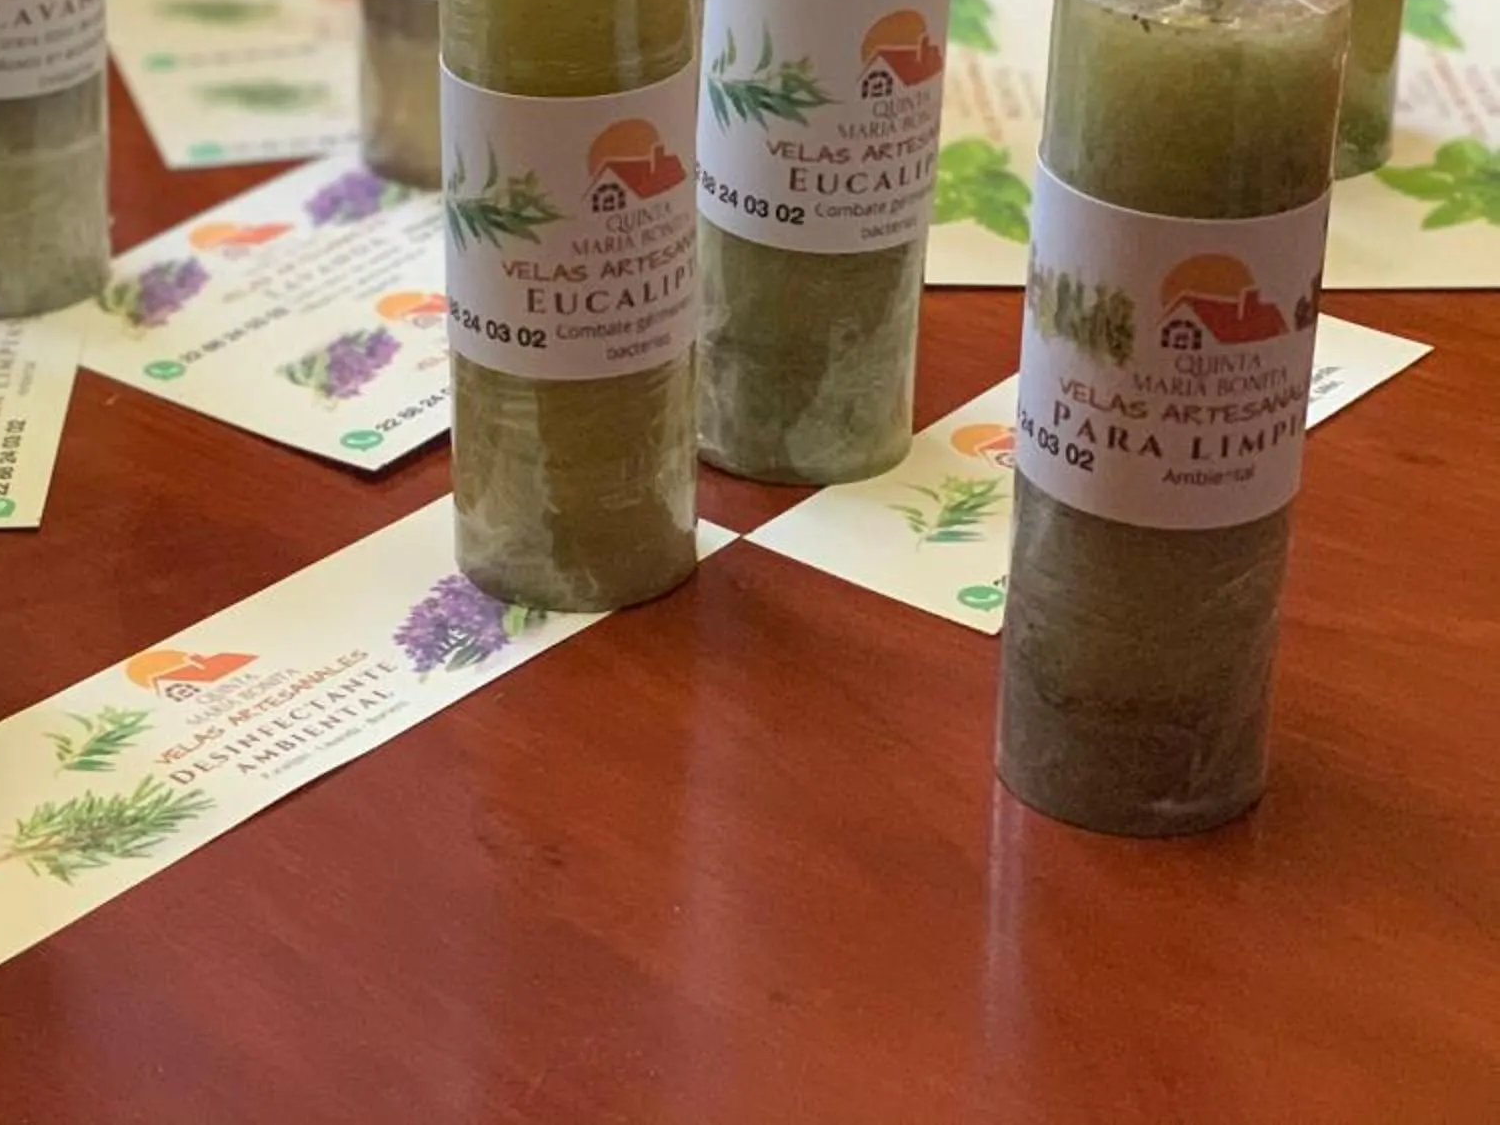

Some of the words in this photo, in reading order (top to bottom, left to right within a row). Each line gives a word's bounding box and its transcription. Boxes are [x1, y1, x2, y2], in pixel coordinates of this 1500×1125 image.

[765, 139, 852, 165] VELAS
[718, 184, 738, 209] 24
[743, 194, 770, 219] 03
[775, 203, 806, 226] 02
[571, 233, 637, 257] MARIA
[501, 259, 589, 282] VELAS
[462, 308, 482, 334] 24
[485, 318, 511, 344] 03
[517, 325, 548, 349] 02
[555, 317, 632, 342] Combate
[1132, 372, 1208, 397] MARIA
[1173, 350, 1263, 378] QUINTA
[1058, 376, 1149, 419] VELAS
[1037, 426, 1060, 457] 03
[1065, 442, 1096, 473] 02
[1053, 399, 1163, 460] PARA
[155, 726, 226, 766] VELAS
[227, 648, 370, 728] ARTESANALES
[169, 658, 400, 786] DESINFECTANTE
[236, 687, 396, 776] AMBIENTAL
